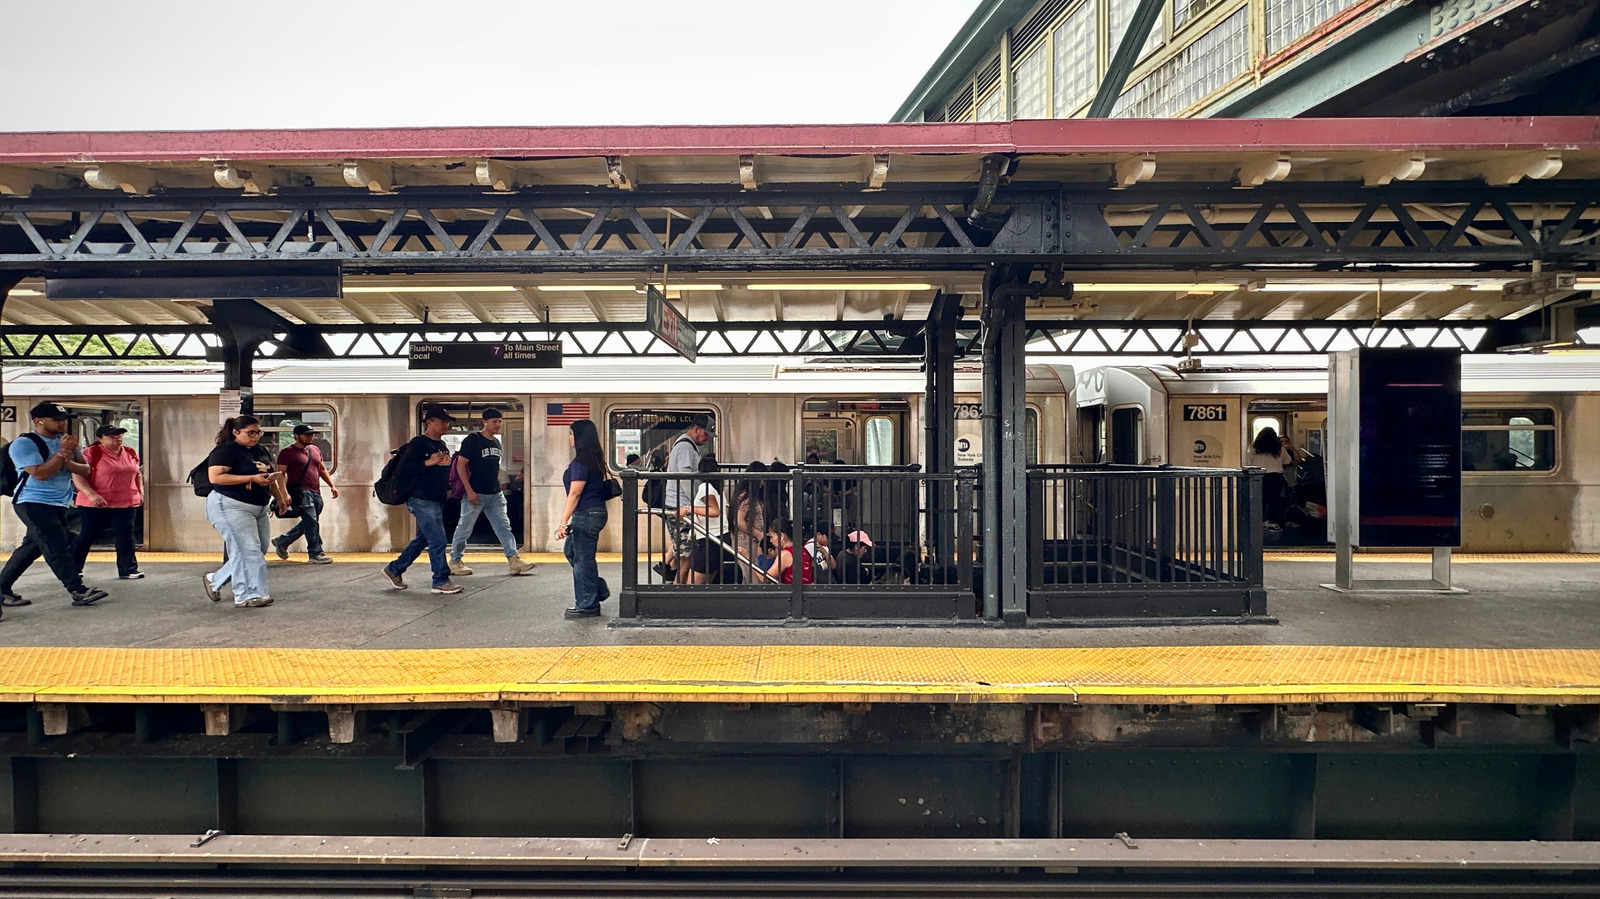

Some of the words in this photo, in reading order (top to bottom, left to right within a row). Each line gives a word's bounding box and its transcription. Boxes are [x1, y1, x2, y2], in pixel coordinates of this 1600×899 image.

[409, 345, 443, 354] Flushing
[494, 346, 500, 355] 7
[409, 352, 430, 360] Local
[1187, 406, 1223, 420] 7861
